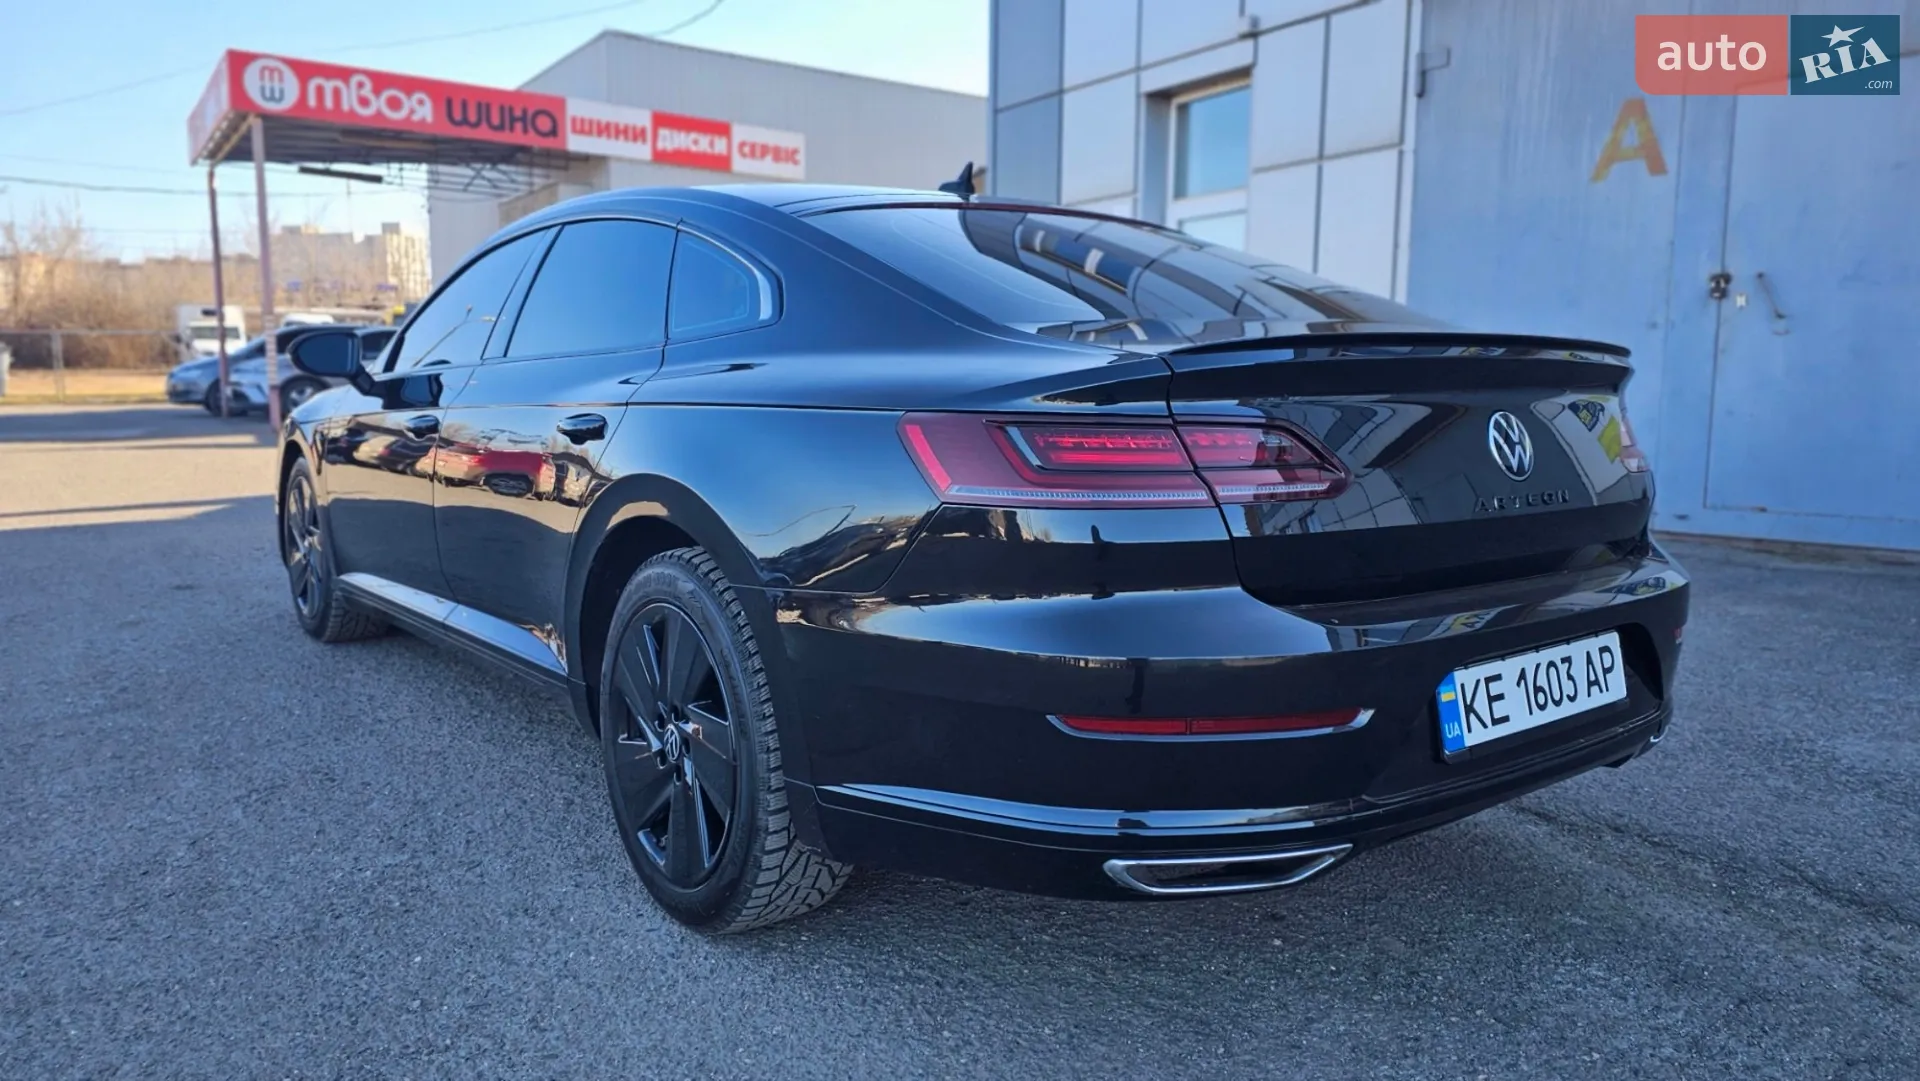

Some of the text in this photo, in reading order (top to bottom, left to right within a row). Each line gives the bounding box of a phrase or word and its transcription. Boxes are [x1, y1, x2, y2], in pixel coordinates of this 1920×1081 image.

[570, 115, 648, 146] ШИНИ
[656, 126, 729, 156] ДИСКИ
[737, 140, 802, 166] СЕРВІС
[1475, 489, 1569, 512] ARTEON
[1460, 645, 1615, 733] KE 1603 AP
[1445, 722, 1462, 738] UA
